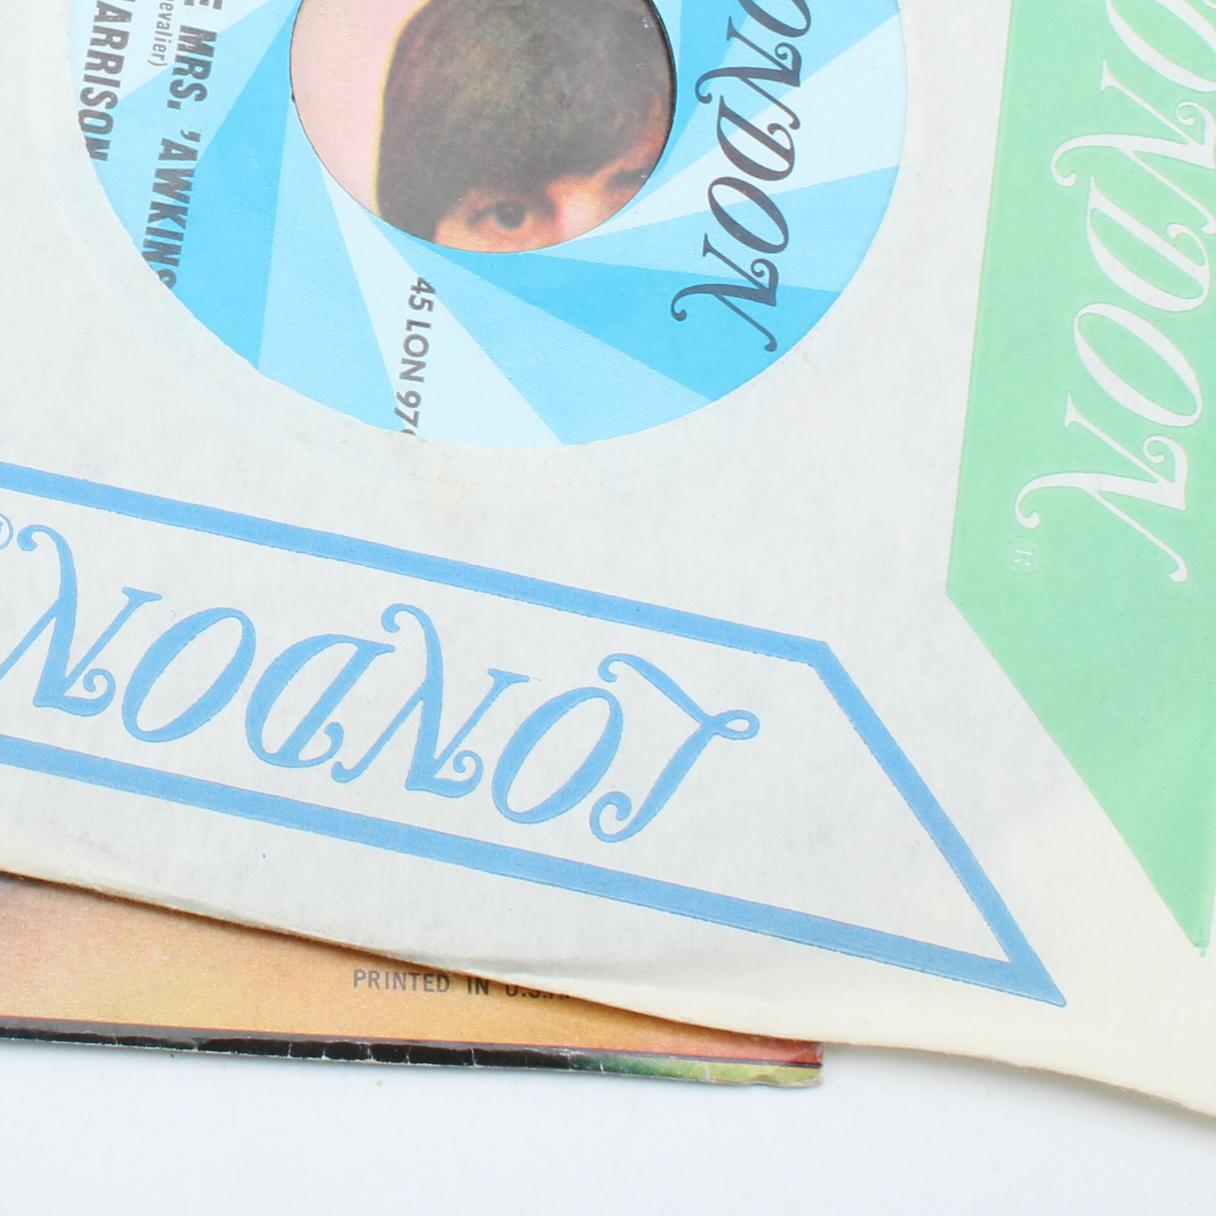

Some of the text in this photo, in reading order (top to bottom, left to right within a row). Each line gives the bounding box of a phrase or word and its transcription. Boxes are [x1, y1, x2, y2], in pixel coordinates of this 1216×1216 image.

[166, 24, 217, 110] MRS.
[394, 276, 436, 436] 45 LON 97
[353, 968, 451, 993] PRINTED
[467, 976, 489, 995] IN
